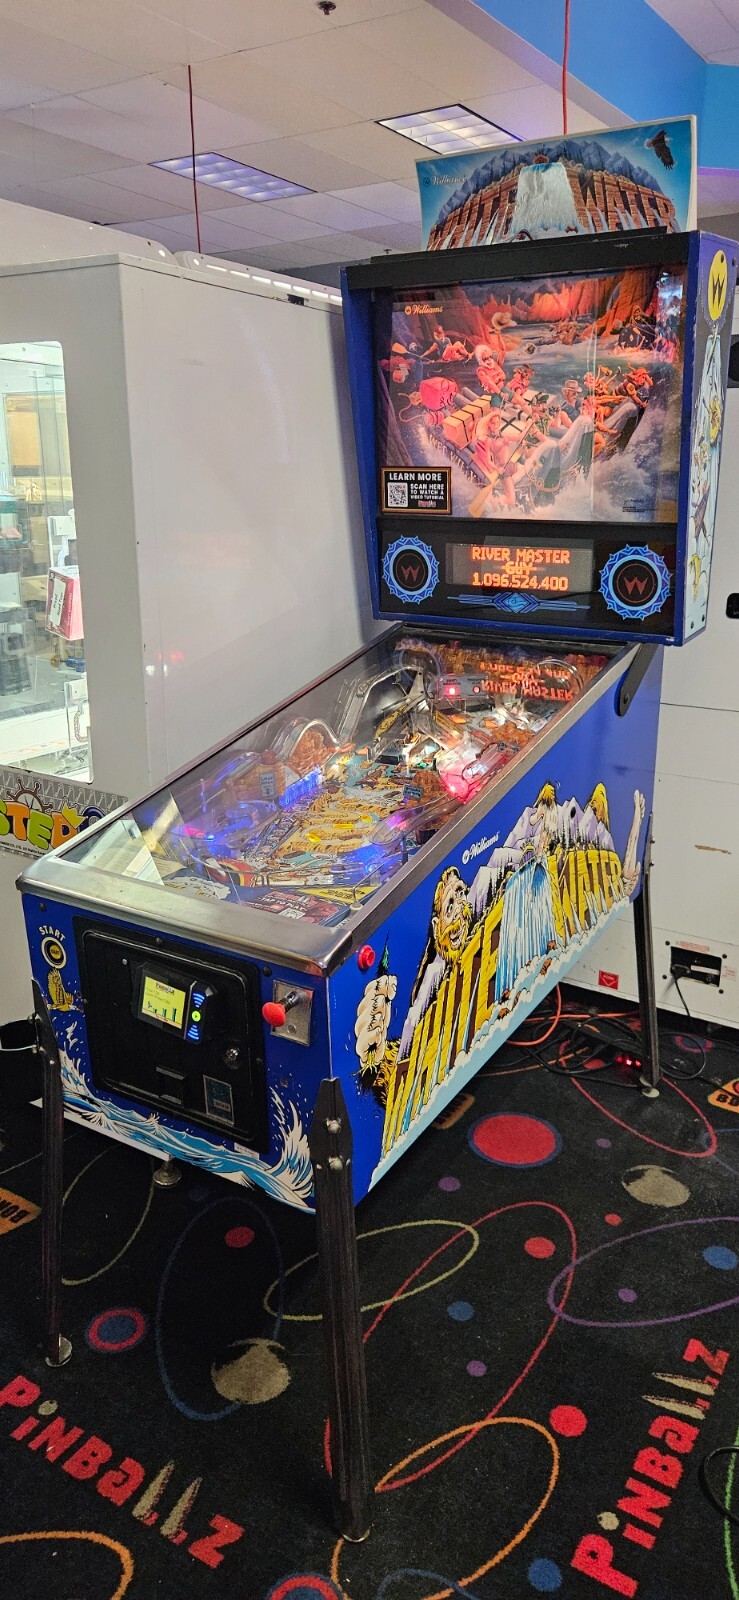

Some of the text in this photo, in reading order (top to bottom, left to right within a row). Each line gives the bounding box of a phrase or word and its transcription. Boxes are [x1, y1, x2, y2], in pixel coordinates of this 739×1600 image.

[411, 304, 443, 315] Williams
[389, 472, 442, 481] LEARN MORE
[472, 547, 570, 564] RIVER MASTER
[472, 572, 569, 591] 1,096,524,400
[470, 831, 500, 860] Williams
[39, 925, 66, 941] START
